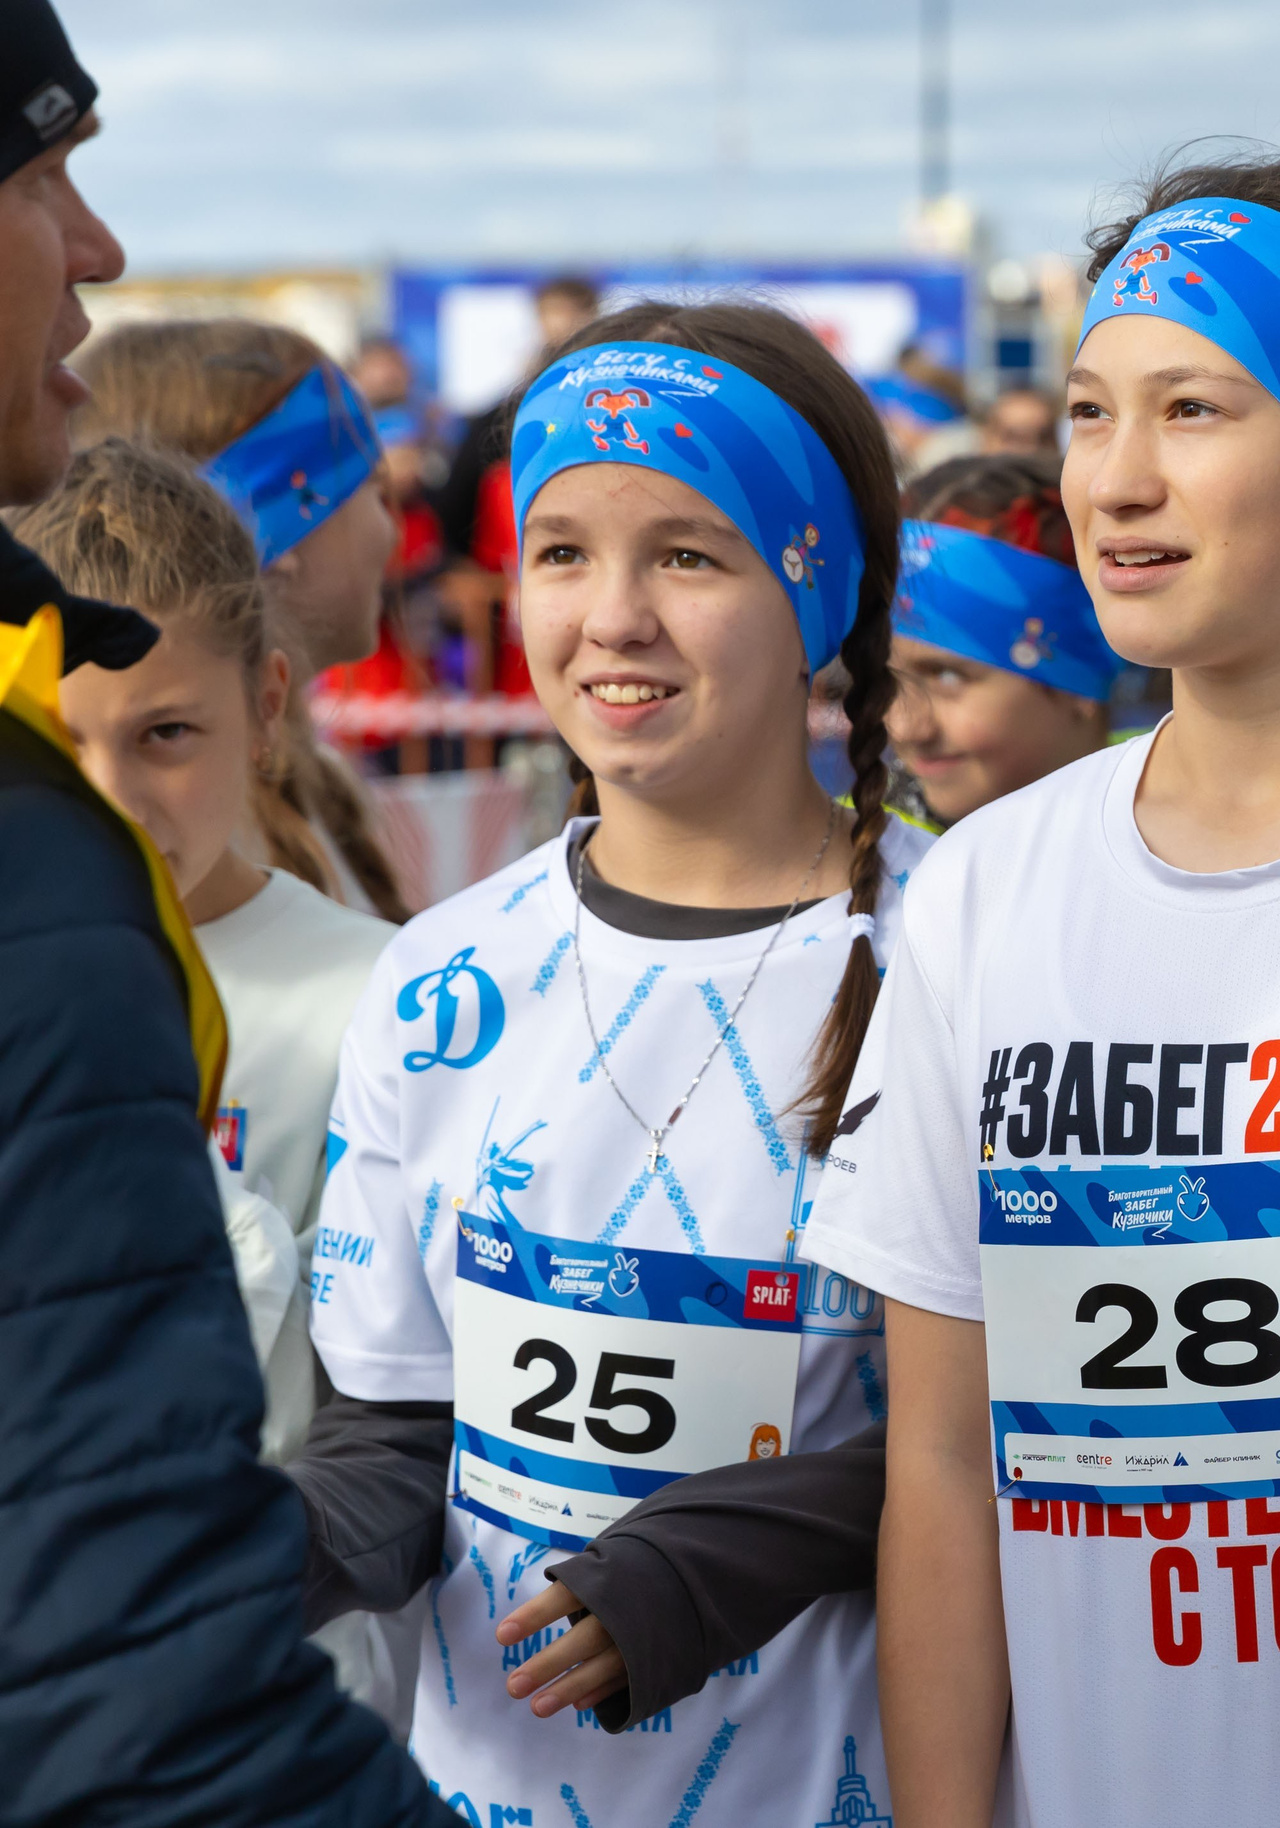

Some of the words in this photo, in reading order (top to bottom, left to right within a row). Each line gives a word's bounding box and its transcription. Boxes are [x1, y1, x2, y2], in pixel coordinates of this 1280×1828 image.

[997, 1189, 1058, 1213] 1000
[1124, 1197, 1159, 1212] ЗАБЕГ
[1005, 1213, 1052, 1226] метров
[1112, 1209, 1174, 1232] Кузнечики
[472, 1232, 513, 1264] 1000
[752, 1285, 790, 1306] SPLAT
[511, 1338, 678, 1455] 25
[1076, 1453, 1113, 1466] centre
[1149, 1546, 1203, 1668] С
